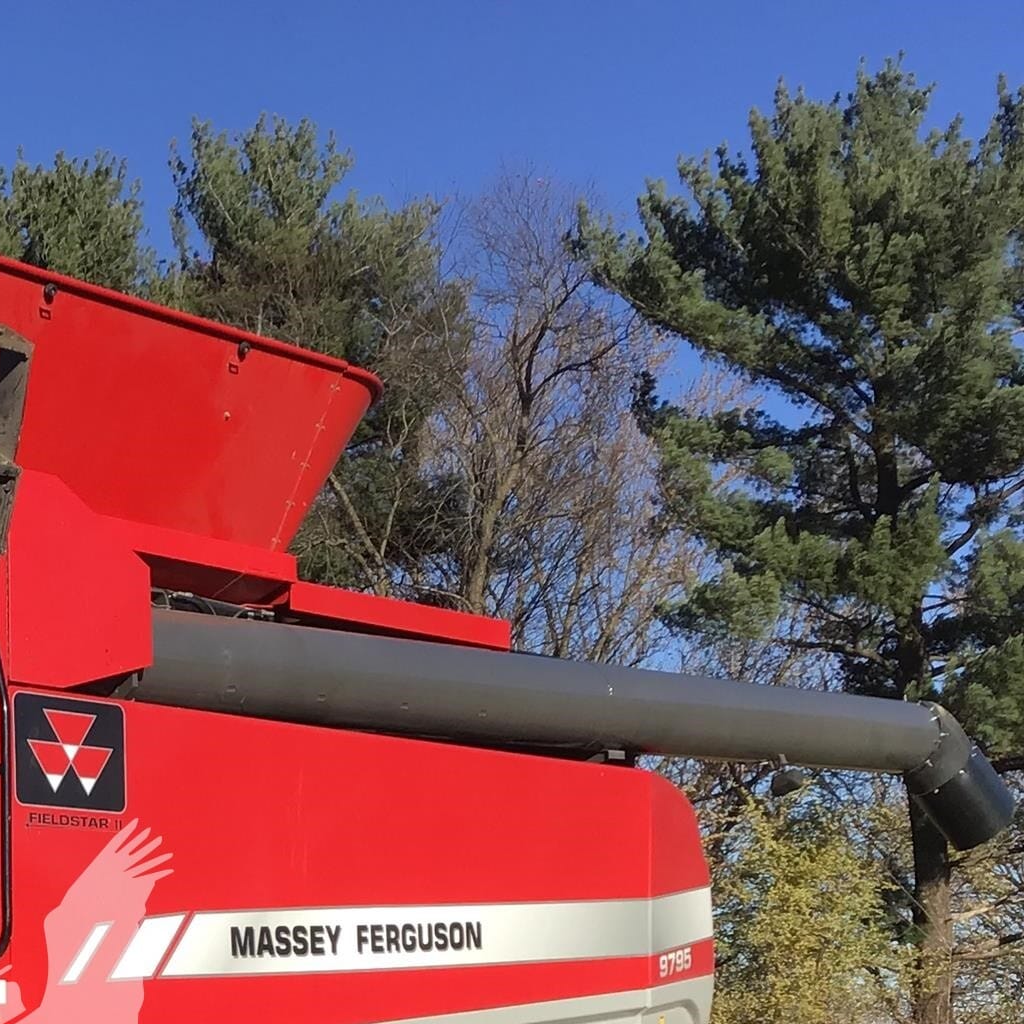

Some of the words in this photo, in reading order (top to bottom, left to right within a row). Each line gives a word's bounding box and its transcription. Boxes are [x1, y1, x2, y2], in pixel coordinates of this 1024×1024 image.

[29, 812, 109, 829] FIELDSTAR
[115, 819, 123, 831] II
[230, 925, 341, 957] MASSEY
[356, 921, 483, 954] FERGUSON
[659, 946, 692, 978] 9795
